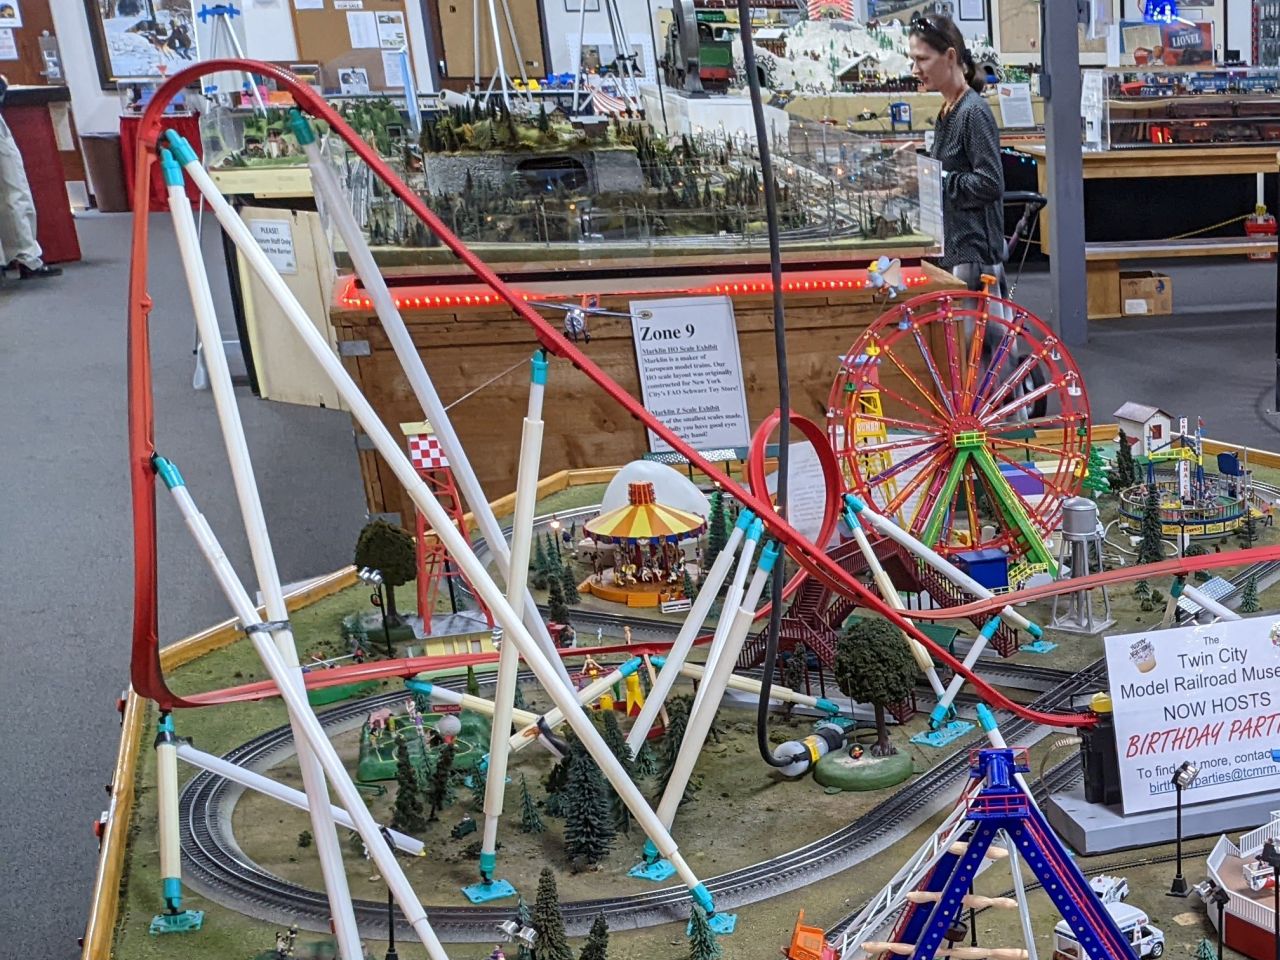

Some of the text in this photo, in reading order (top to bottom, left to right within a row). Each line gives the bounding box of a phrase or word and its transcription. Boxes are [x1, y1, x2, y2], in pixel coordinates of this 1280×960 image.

[1172, 33, 1201, 47] LIONEL
[640, 323, 695, 341] Zone 9
[680, 345, 695, 353] Scale
[696, 344, 718, 352] Exhibit
[645, 365, 674, 373] European
[673, 371, 691, 379] layout
[705, 369, 733, 377] originally
[648, 381, 681, 389] constructed
[698, 405, 720, 413] Exhibit
[1203, 636, 1219, 646] The
[1177, 647, 1248, 669] Twin City
[1120, 679, 1169, 700] Model
[1174, 669, 1237, 691] Railroad
[1164, 691, 1271, 722] NOW HOSTS
[1126, 721, 1225, 758] BIRTHDAY
[1137, 768, 1152, 780] To
[1156, 765, 1176, 777] find
[1200, 758, 1232, 770] more,
